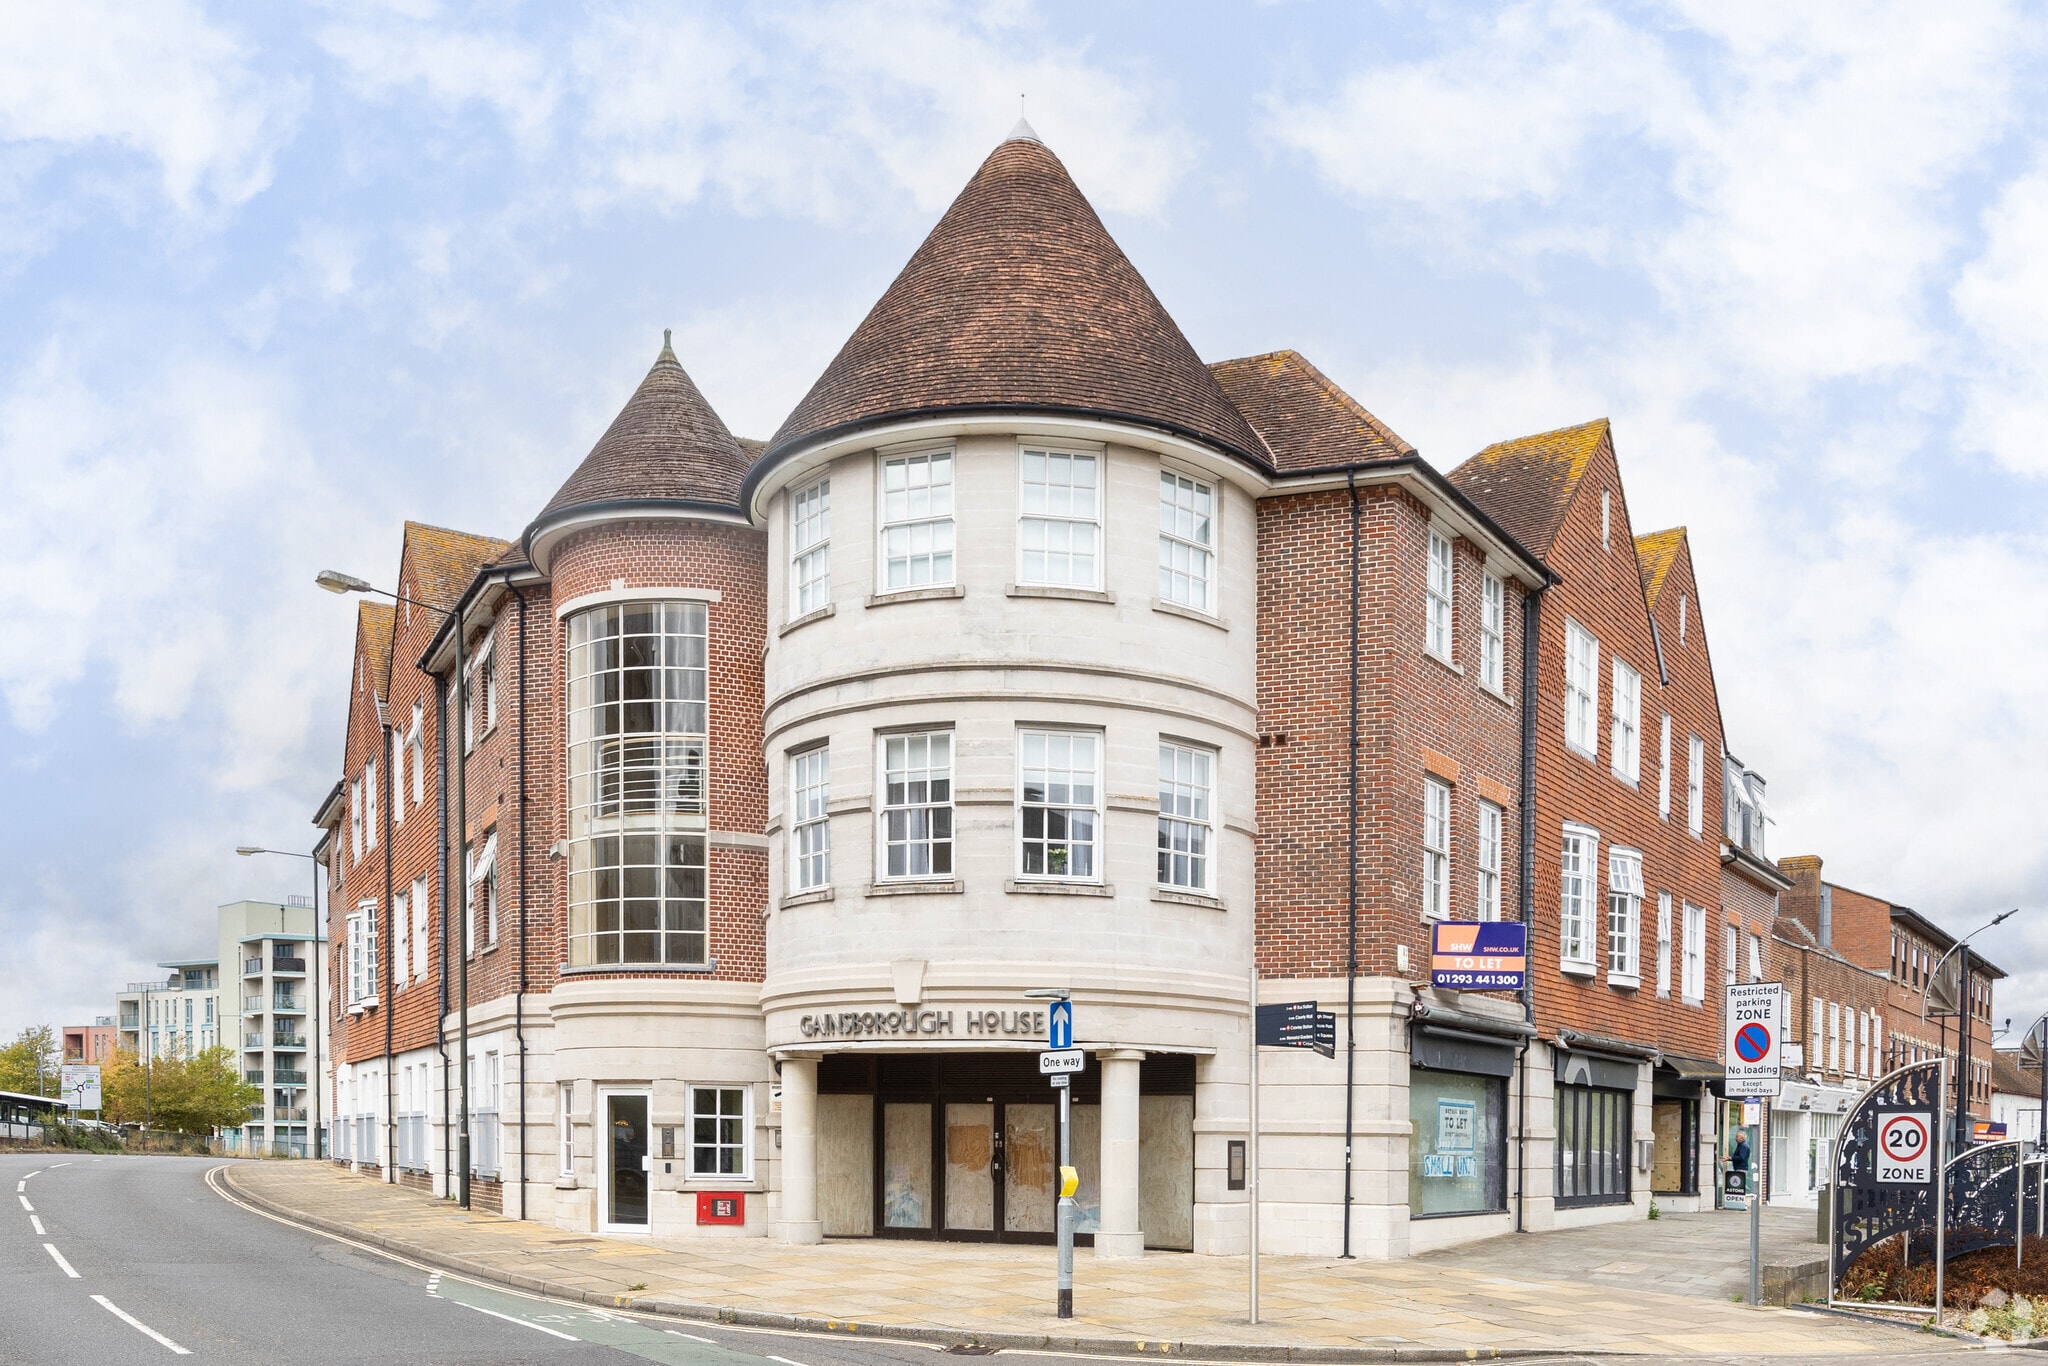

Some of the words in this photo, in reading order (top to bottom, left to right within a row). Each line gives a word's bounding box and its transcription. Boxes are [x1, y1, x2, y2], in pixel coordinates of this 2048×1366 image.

[1450, 943, 1472, 951] SHW
[1454, 957, 1474, 969] TO
[1479, 957, 1502, 969] LET
[1437, 973, 1472, 984] 01293
[1475, 974, 1518, 985] 441300
[1730, 985, 1779, 997] Restricted
[1736, 997, 1771, 1008] parking
[1736, 1008, 1771, 1020] ZONE
[800, 1010, 954, 1037] GAINSBOROUGH
[967, 1010, 1046, 1035] HOUSE
[1043, 1057, 1060, 1068] One
[1063, 1057, 1080, 1068] way
[1728, 1065, 1740, 1075] No
[1744, 1064, 1778, 1075] loading
[1742, 1080, 1762, 1088] Except
[1759, 1086, 1773, 1094] bays
[1444, 1116, 1454, 1129] TO
[1456, 1118, 1468, 1130] LET
[1888, 1129, 1921, 1148] 20
[1882, 1168, 1925, 1180] ZONE
